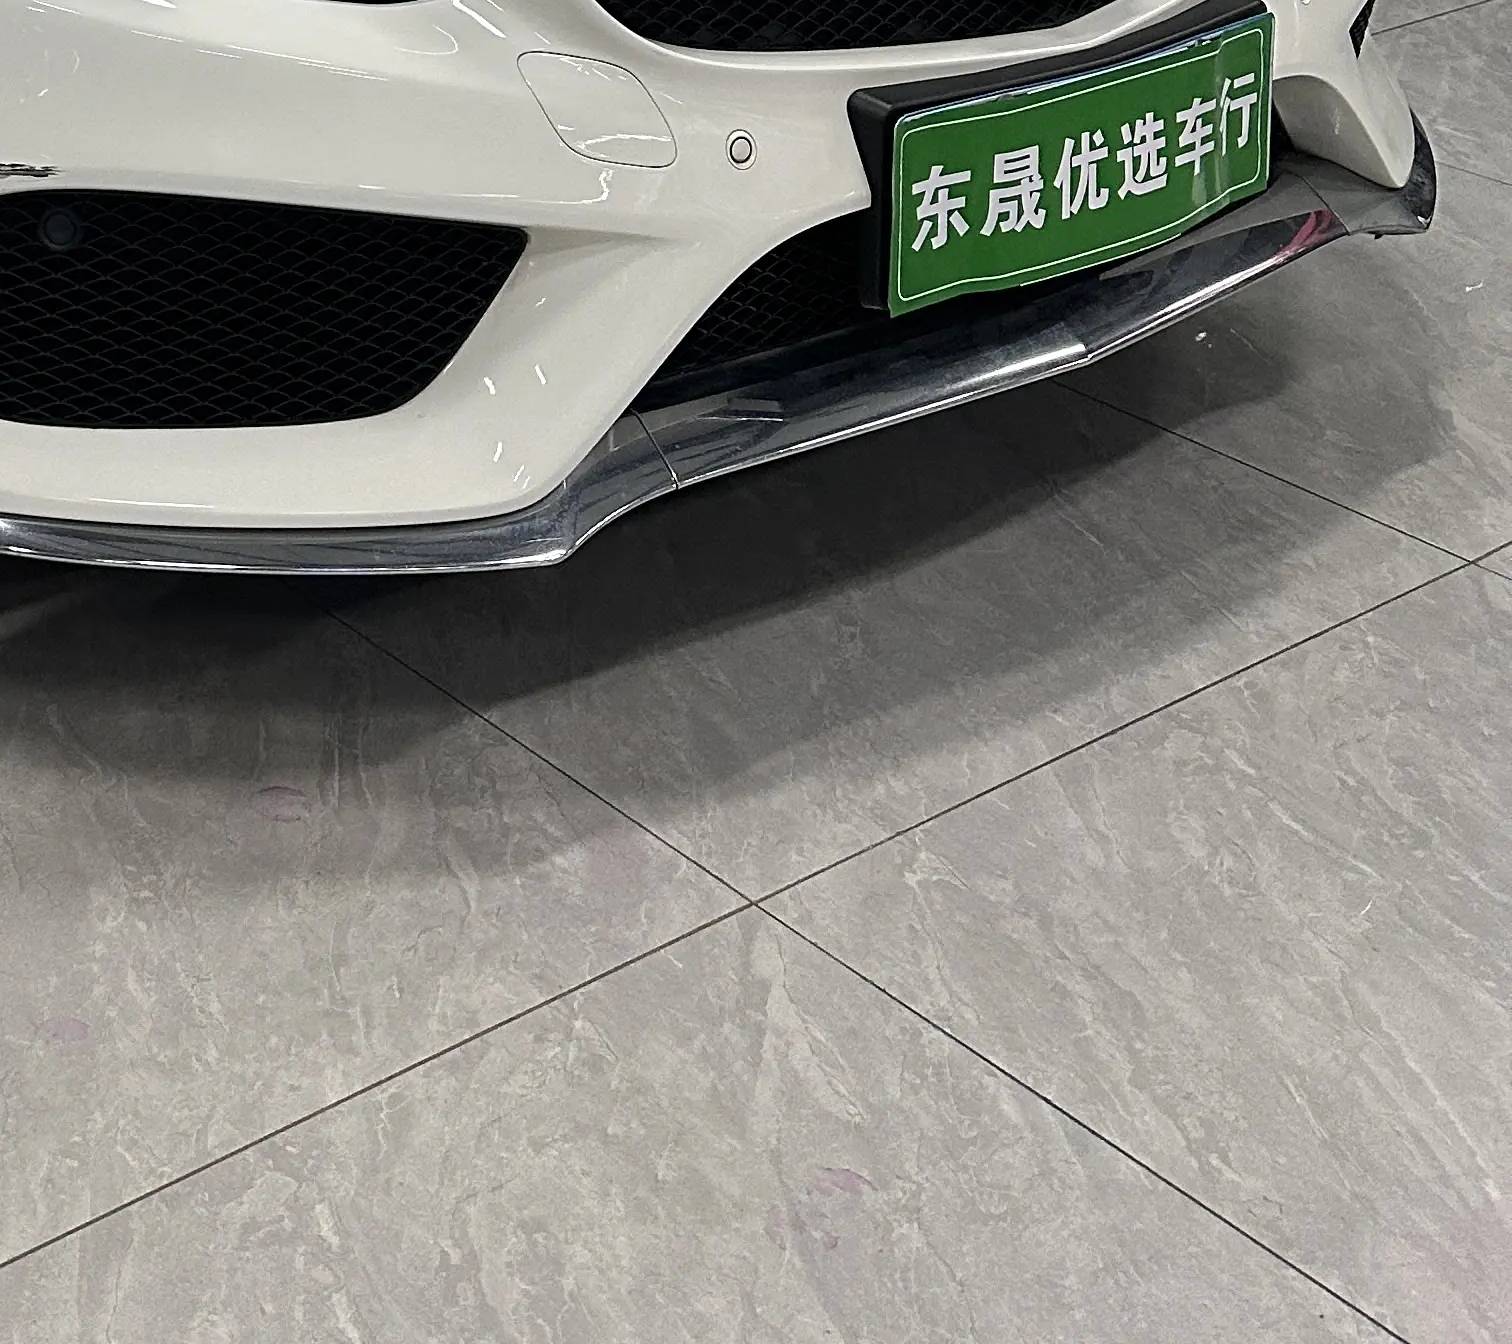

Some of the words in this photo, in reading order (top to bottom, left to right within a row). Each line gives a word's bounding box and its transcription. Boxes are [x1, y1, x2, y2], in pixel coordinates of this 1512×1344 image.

[911, 72, 1259, 254] 东晟优选车行
